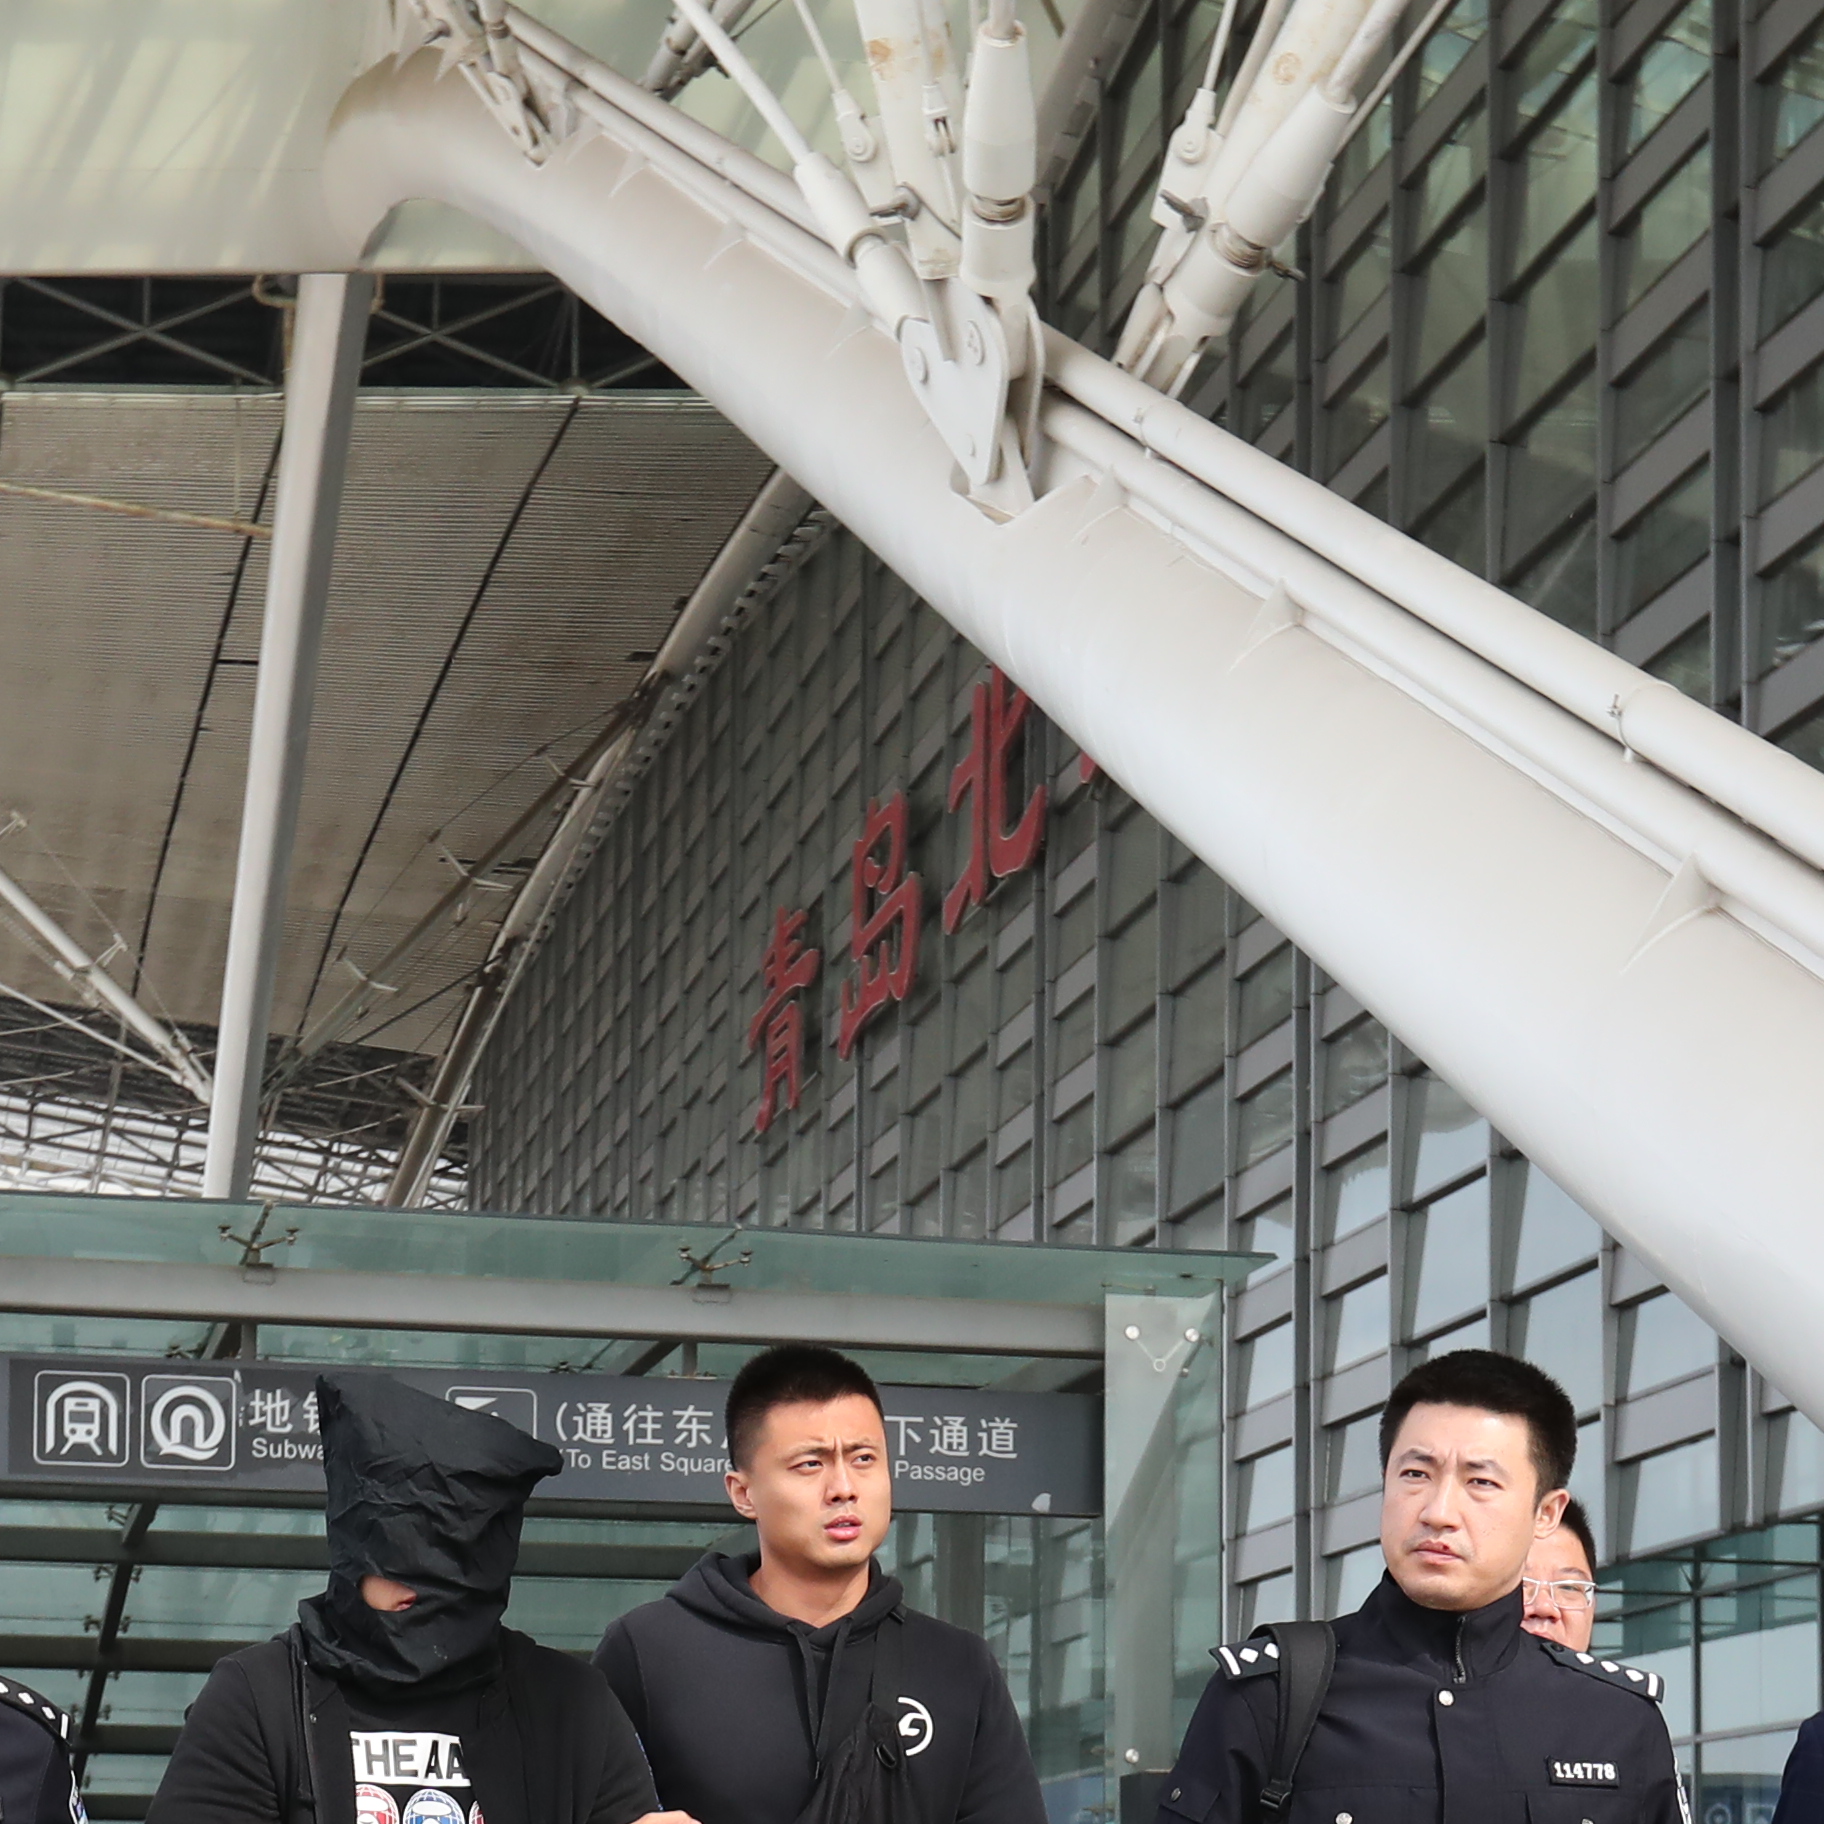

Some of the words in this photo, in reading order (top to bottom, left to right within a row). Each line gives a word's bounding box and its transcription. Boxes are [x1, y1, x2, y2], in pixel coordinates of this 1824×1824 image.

[749, 660, 1097, 1133] 青岛北
[555, 1402, 728, 1448] (通往东
[884, 1415, 1018, 1458] 下通道
[560, 1448, 591, 1468] To
[602, 1450, 650, 1470] East
[660, 1451, 733, 1475] Square
[894, 1460, 985, 1486] Passage
[1554, 1762, 1615, 1779] 114778
